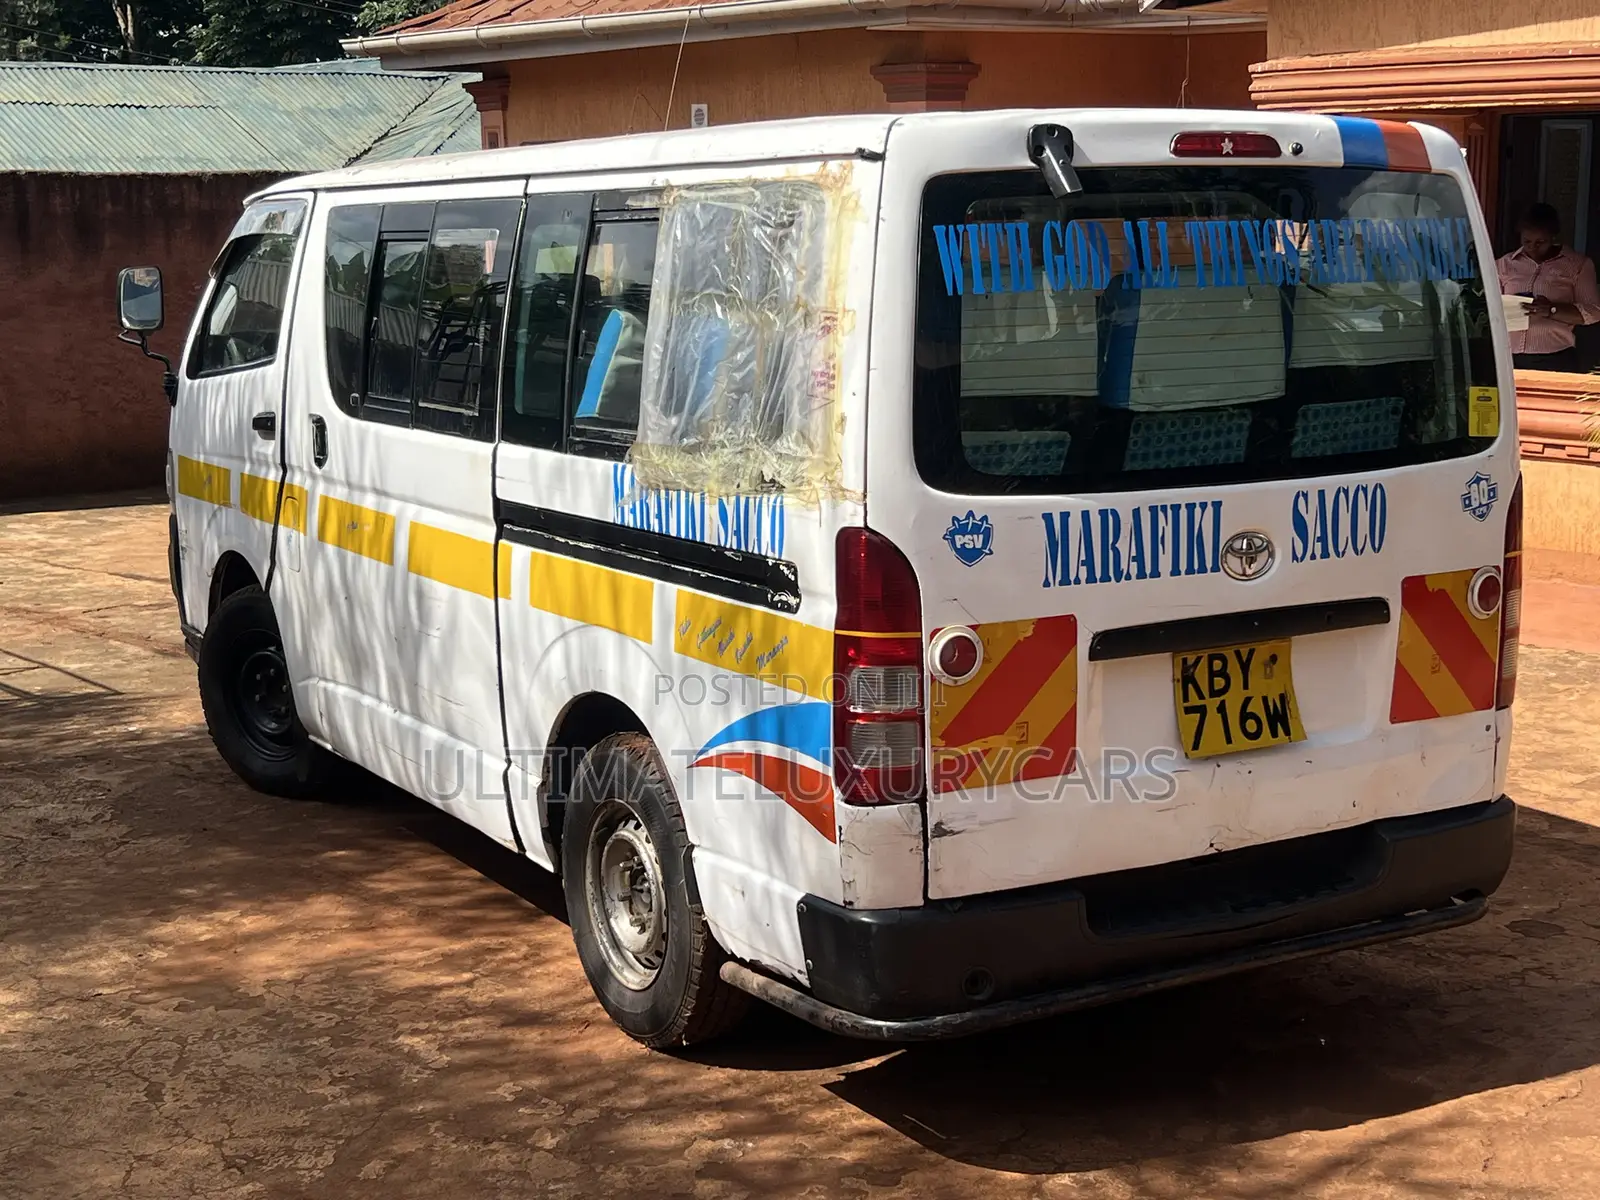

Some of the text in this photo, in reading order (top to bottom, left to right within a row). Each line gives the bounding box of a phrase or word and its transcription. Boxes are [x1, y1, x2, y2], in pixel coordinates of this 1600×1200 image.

[933, 222, 1035, 296] WITH
[1042, 219, 1110, 292] GOD
[1122, 219, 1180, 289] ALL
[1184, 219, 1300, 288] THINGS
[1307, 218, 1364, 284] ARE
[954, 534, 984, 549] PSV
[1041, 482, 1387, 588] MARAFIKI SACCO
[1181, 648, 1256, 703] KBY
[1183, 692, 1292, 751] 716W
